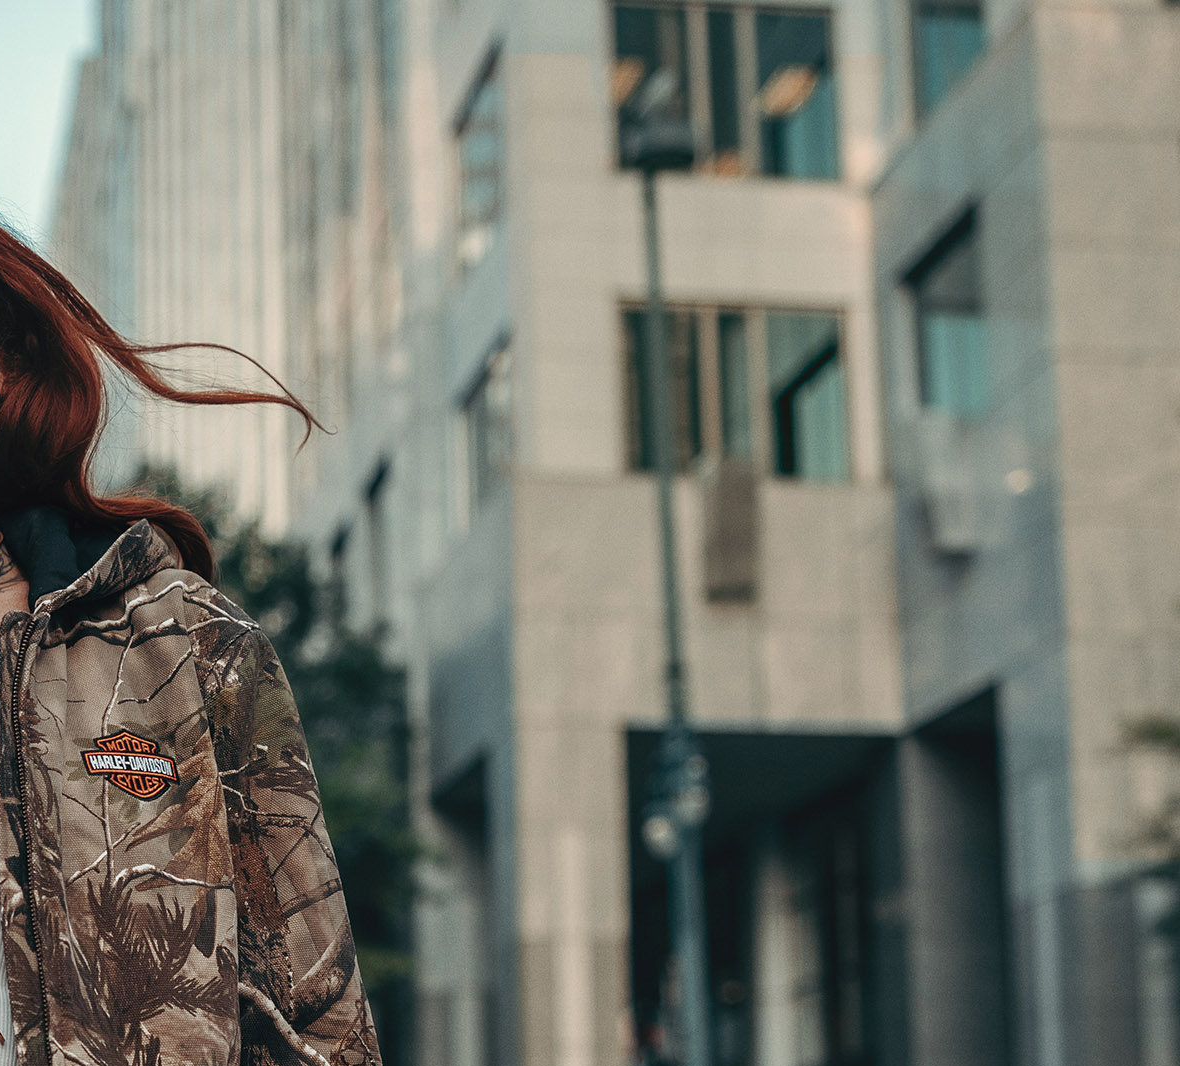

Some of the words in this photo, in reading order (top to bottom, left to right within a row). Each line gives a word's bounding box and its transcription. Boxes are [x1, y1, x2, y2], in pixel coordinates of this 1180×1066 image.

[106, 737, 151, 753] MOTOR
[88, 755, 173, 776] HARLEY-DAVIDSON
[116, 774, 160, 793] CYCLES
